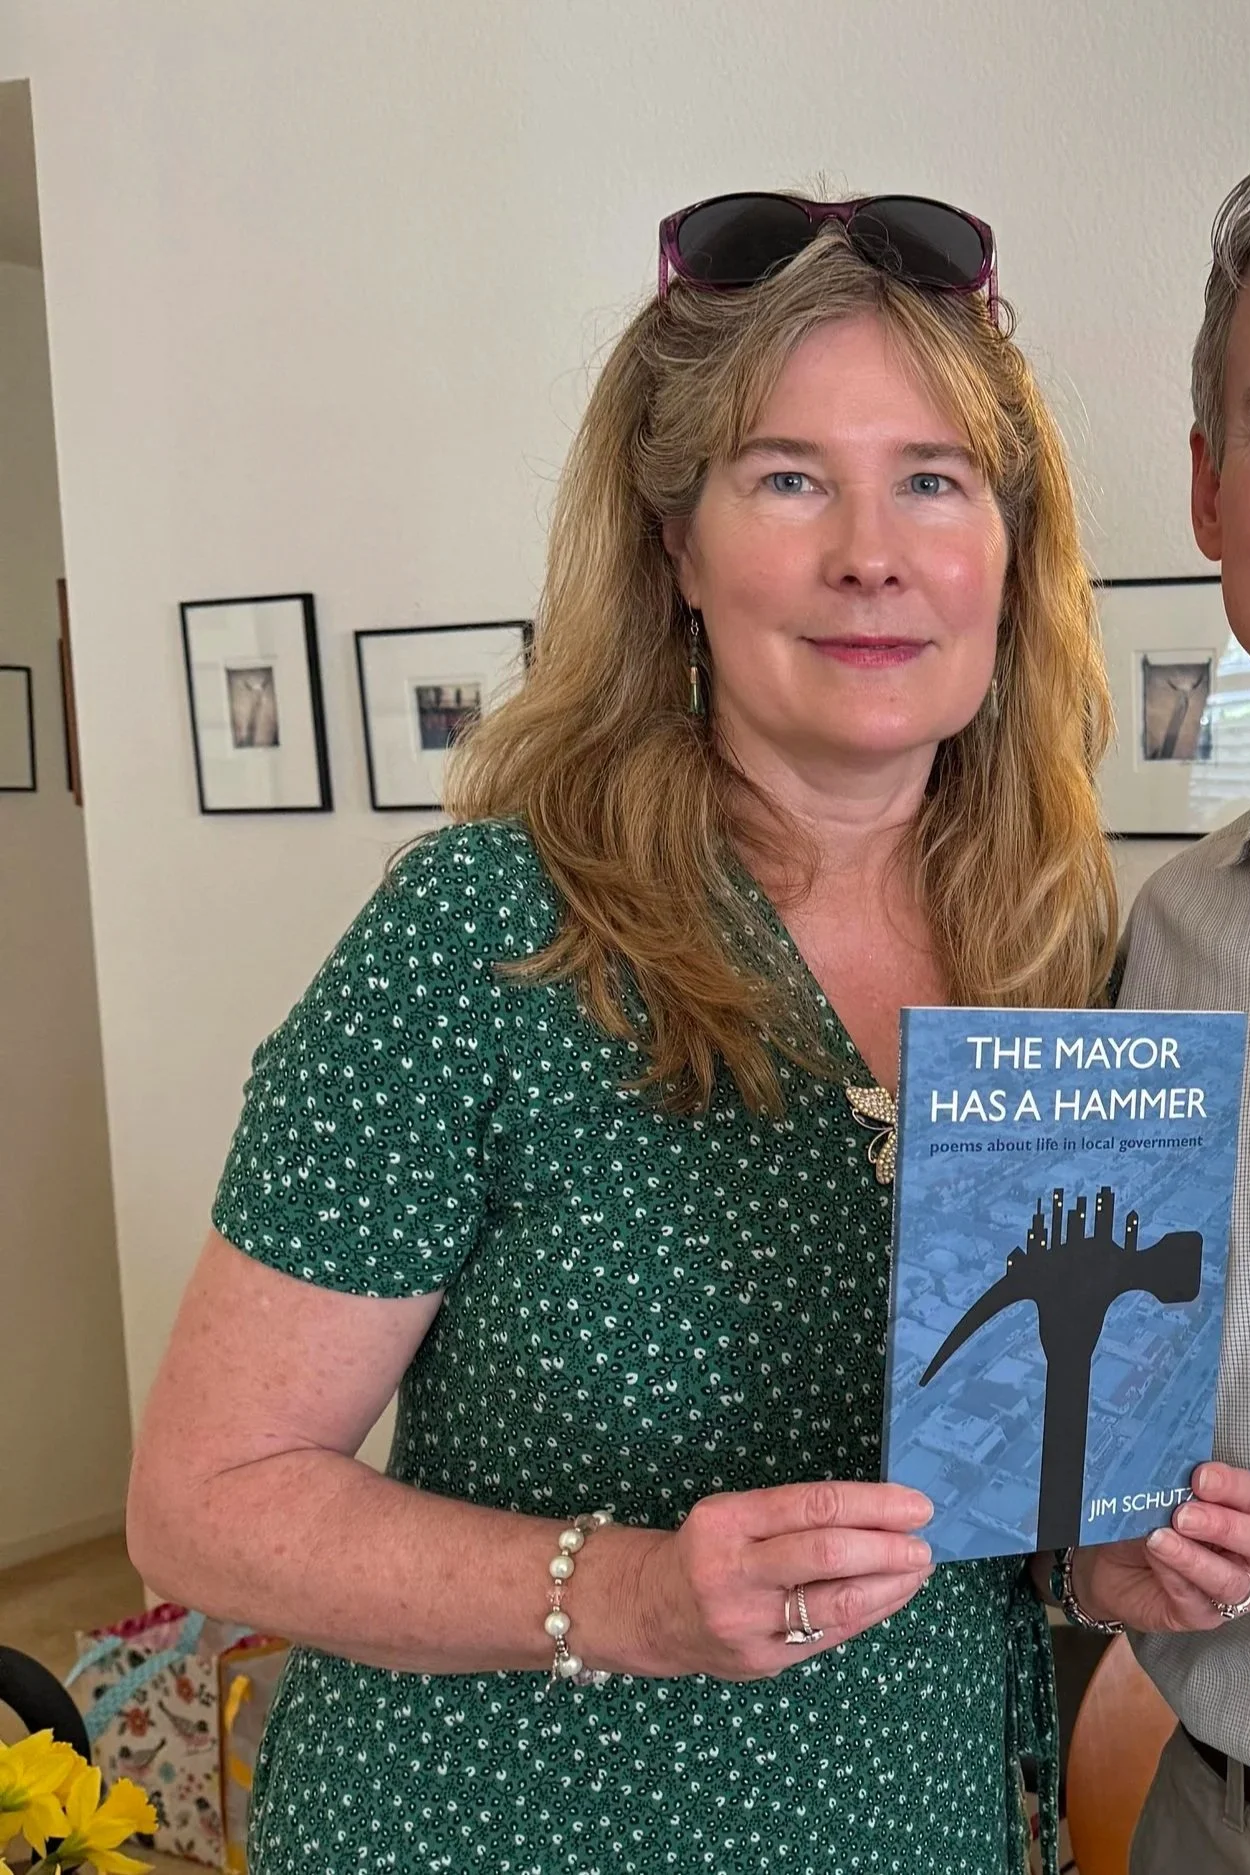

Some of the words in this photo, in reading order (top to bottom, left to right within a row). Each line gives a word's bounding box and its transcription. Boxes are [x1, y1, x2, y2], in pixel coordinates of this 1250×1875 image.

[967, 1036, 1043, 1070] THE
[1055, 1036, 1181, 1070] MAYOR
[931, 1089, 1007, 1122] HAS
[1013, 1089, 1042, 1121] A
[1054, 1087, 1208, 1121] HAMMER
[930, 1141, 983, 1156] poems
[987, 1138, 1032, 1152] about
[1036, 1137, 1059, 1152] life
[1063, 1137, 1076, 1151] in
[1081, 1136, 1115, 1150] local
[1119, 1135, 1204, 1153] government
[1088, 1497, 1116, 1522] JIM
